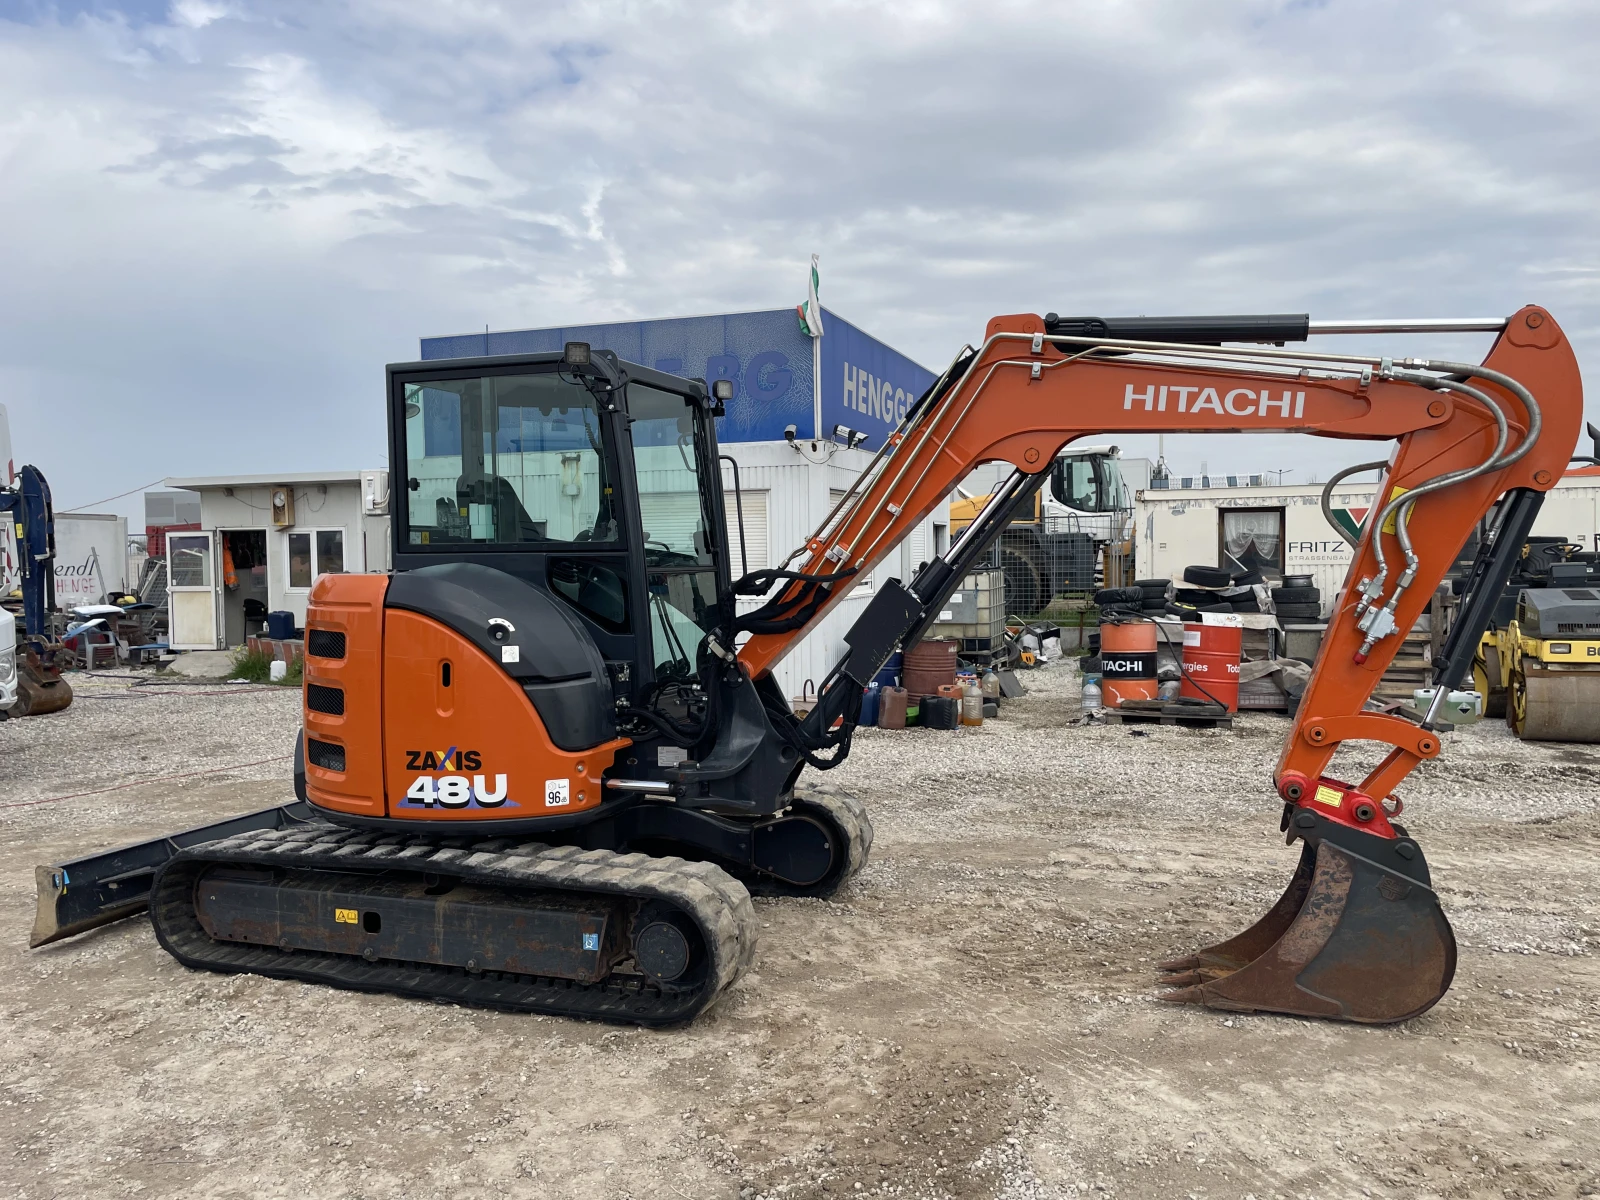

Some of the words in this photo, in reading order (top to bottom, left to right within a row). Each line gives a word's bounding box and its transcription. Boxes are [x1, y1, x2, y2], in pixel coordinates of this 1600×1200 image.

[1123, 383, 1306, 419] HITACHI
[1288, 541, 1345, 553] FRITZ
[1586, 646, 1600, 657] B
[405, 746, 482, 772] ZAXIS
[406, 773, 508, 809] 48U
[548, 791, 561, 804] 96
